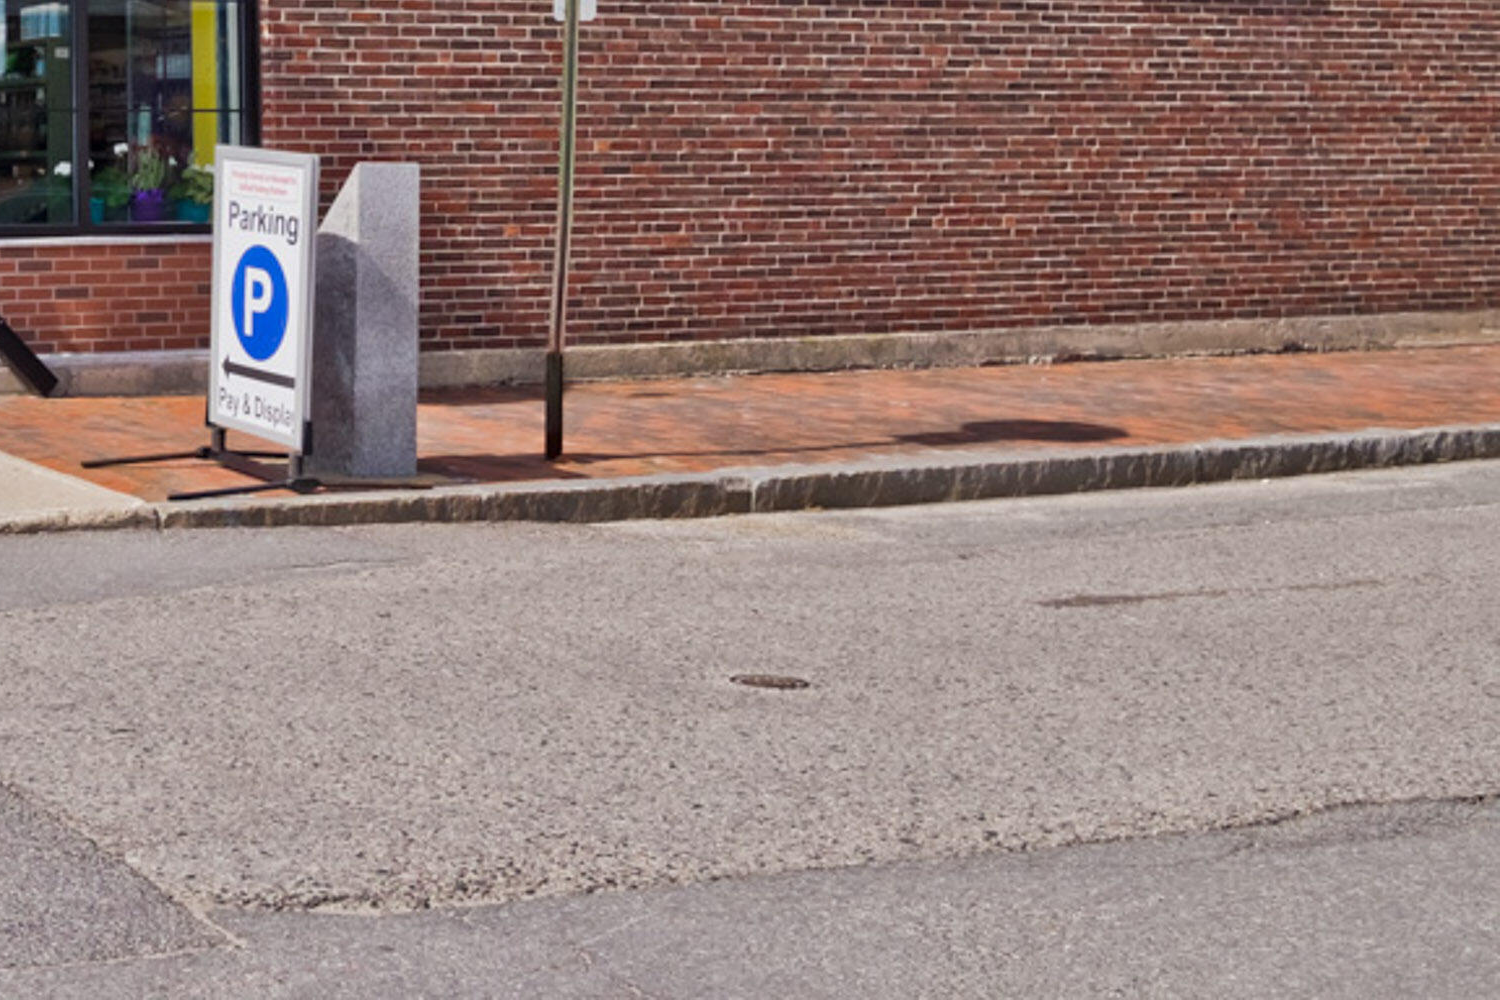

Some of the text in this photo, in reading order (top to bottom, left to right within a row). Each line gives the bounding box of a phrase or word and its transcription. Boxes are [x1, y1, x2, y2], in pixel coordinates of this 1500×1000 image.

[228, 199, 299, 246] Parking
[243, 265, 274, 337] P
[218, 386, 296, 434] Pay & Displa
